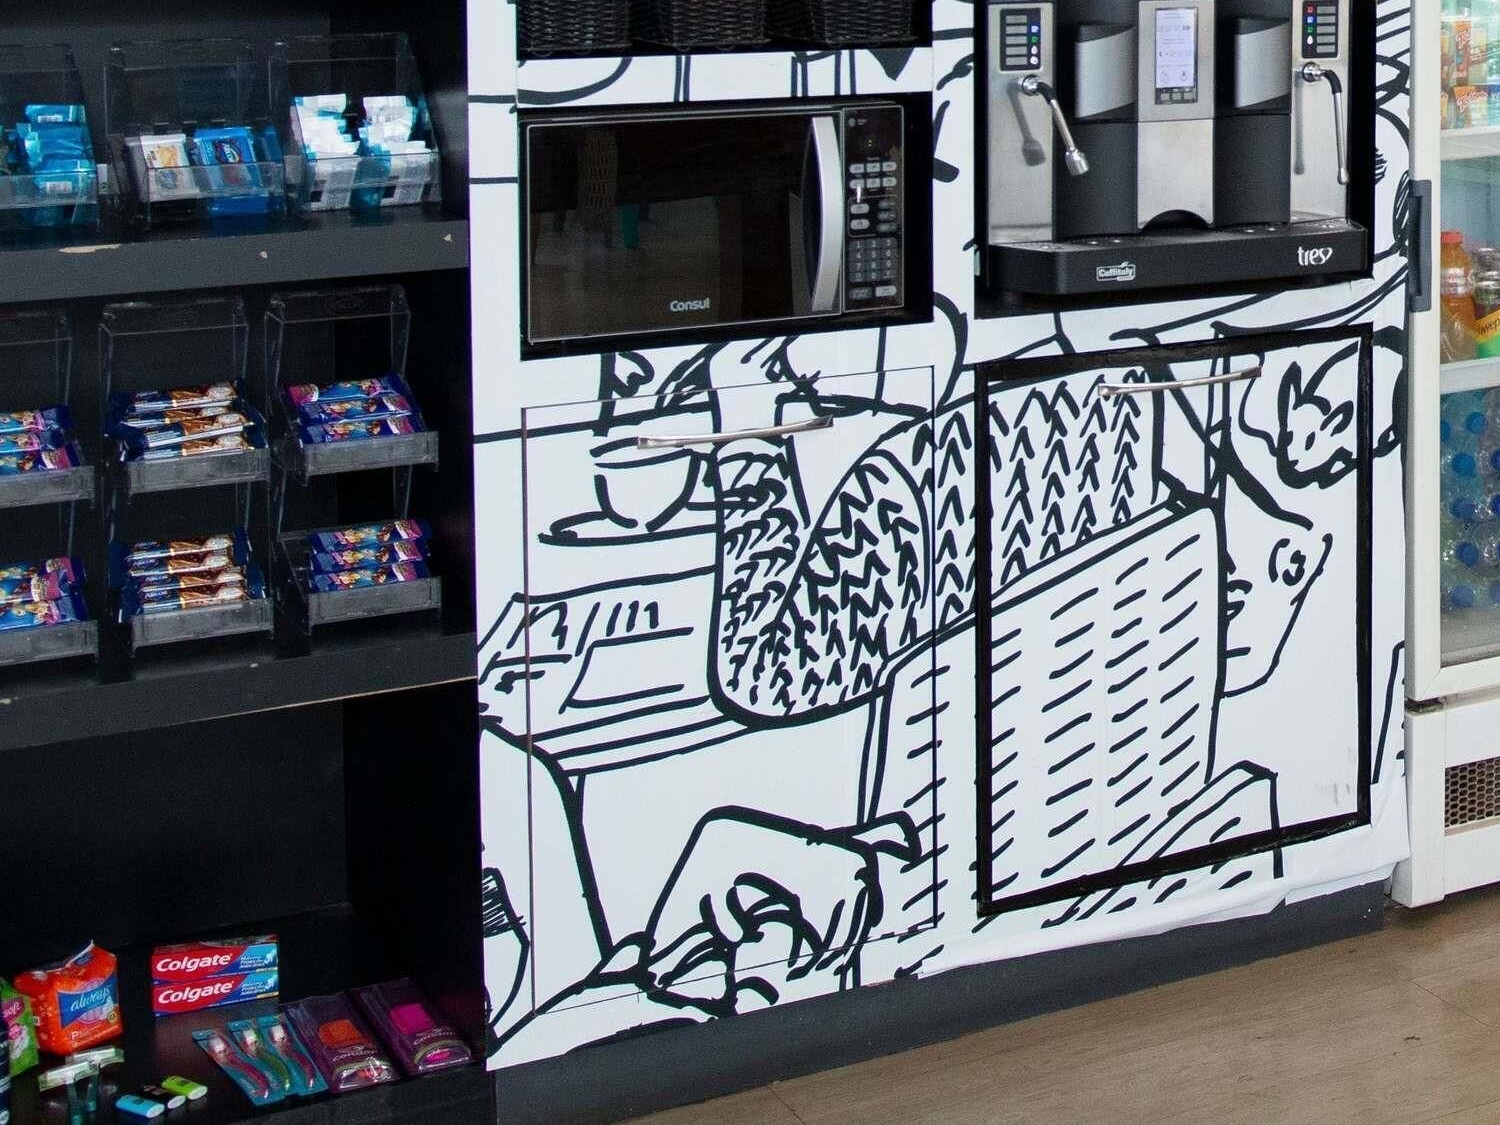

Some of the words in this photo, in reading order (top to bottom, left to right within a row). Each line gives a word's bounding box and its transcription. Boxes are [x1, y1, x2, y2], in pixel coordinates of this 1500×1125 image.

[670, 297, 710, 312] Consul
[156, 953, 232, 972] Colgate
[157, 981, 234, 1004] Colgate
